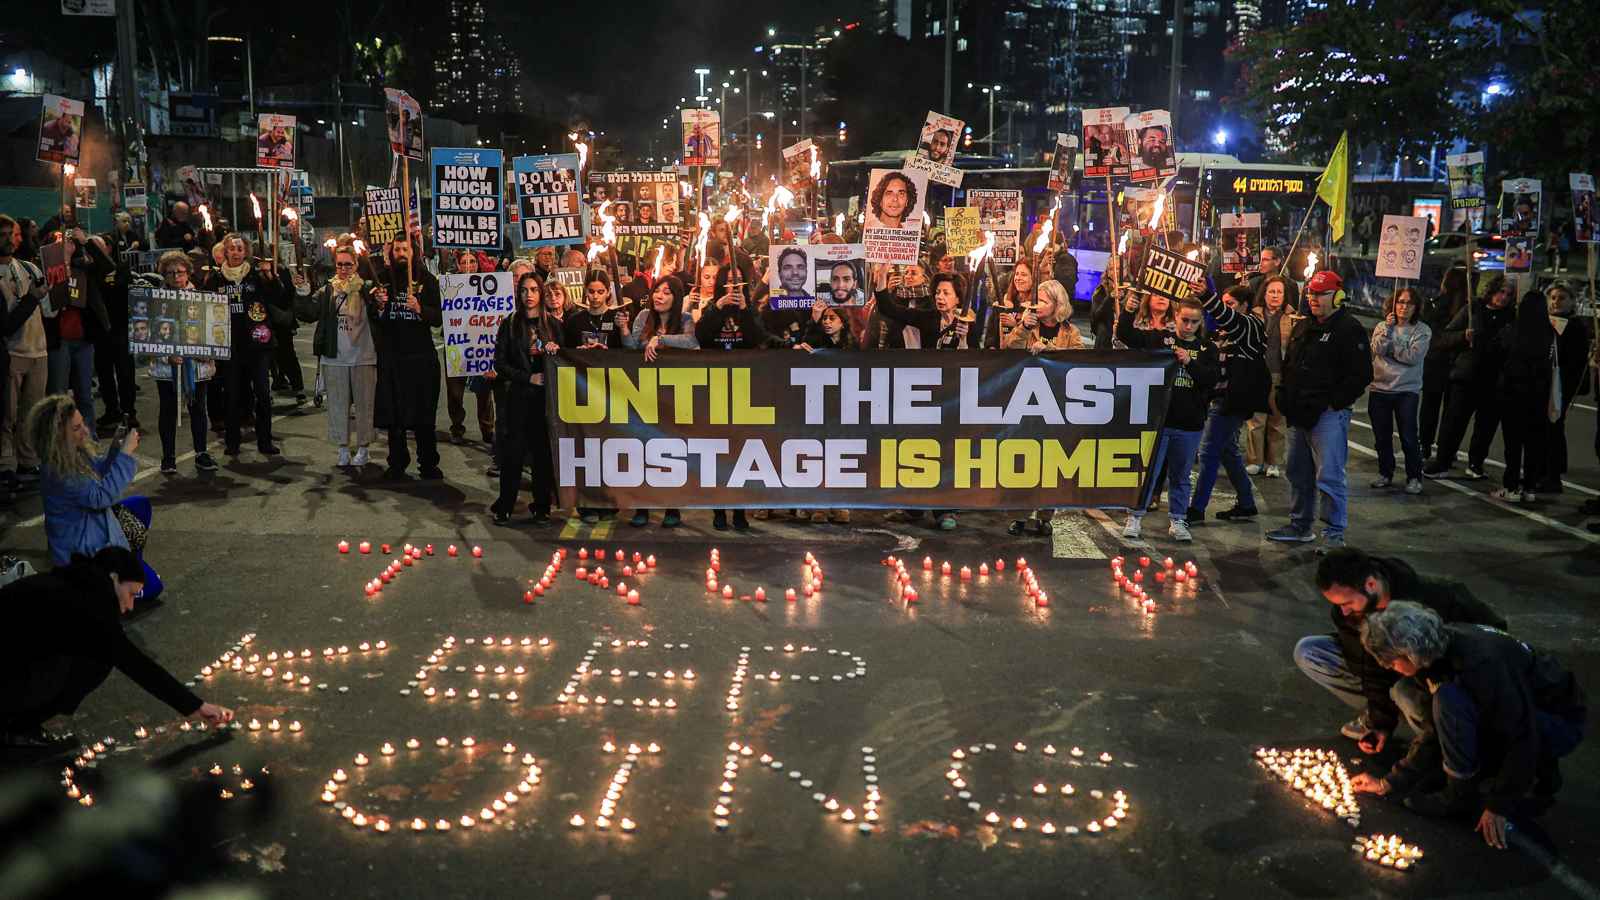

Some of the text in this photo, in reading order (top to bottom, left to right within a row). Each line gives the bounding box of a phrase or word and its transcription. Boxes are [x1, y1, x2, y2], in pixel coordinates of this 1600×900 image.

[445, 166, 487, 180] HOW
[608, 173, 629, 183] כולם
[631, 172, 652, 182] כולל
[654, 173, 675, 183] כולם
[441, 181, 492, 195] MUCH
[525, 180, 576, 195] BLOW
[1233, 177, 1247, 193] 44
[365, 188, 399, 201] תוציאו
[439, 196, 495, 211] BLOOD
[530, 195, 569, 216] THE
[368, 212, 403, 231] וצאו
[437, 215, 497, 230] WILL BE
[525, 218, 579, 240] DEAL
[631, 226, 663, 235] החטוף
[664, 226, 678, 234] עד
[437, 230, 498, 245] SPILLED?
[469, 274, 498, 295] 90
[152, 289, 176, 300] כולם
[179, 290, 202, 301] כולל
[205, 293, 228, 303] כולם
[442, 296, 514, 312] HOSTAGES
[778, 299, 798, 308] BRING
[448, 333, 470, 346] ALL
[176, 346, 211, 357] החטוף
[215, 347, 228, 357] עד
[464, 348, 496, 359] COM
[557, 366, 1164, 424] UNTIL THE LAST
[559, 431, 1158, 488] HOSTAGE IS HOME!
[185, 632, 869, 714] KEEP
